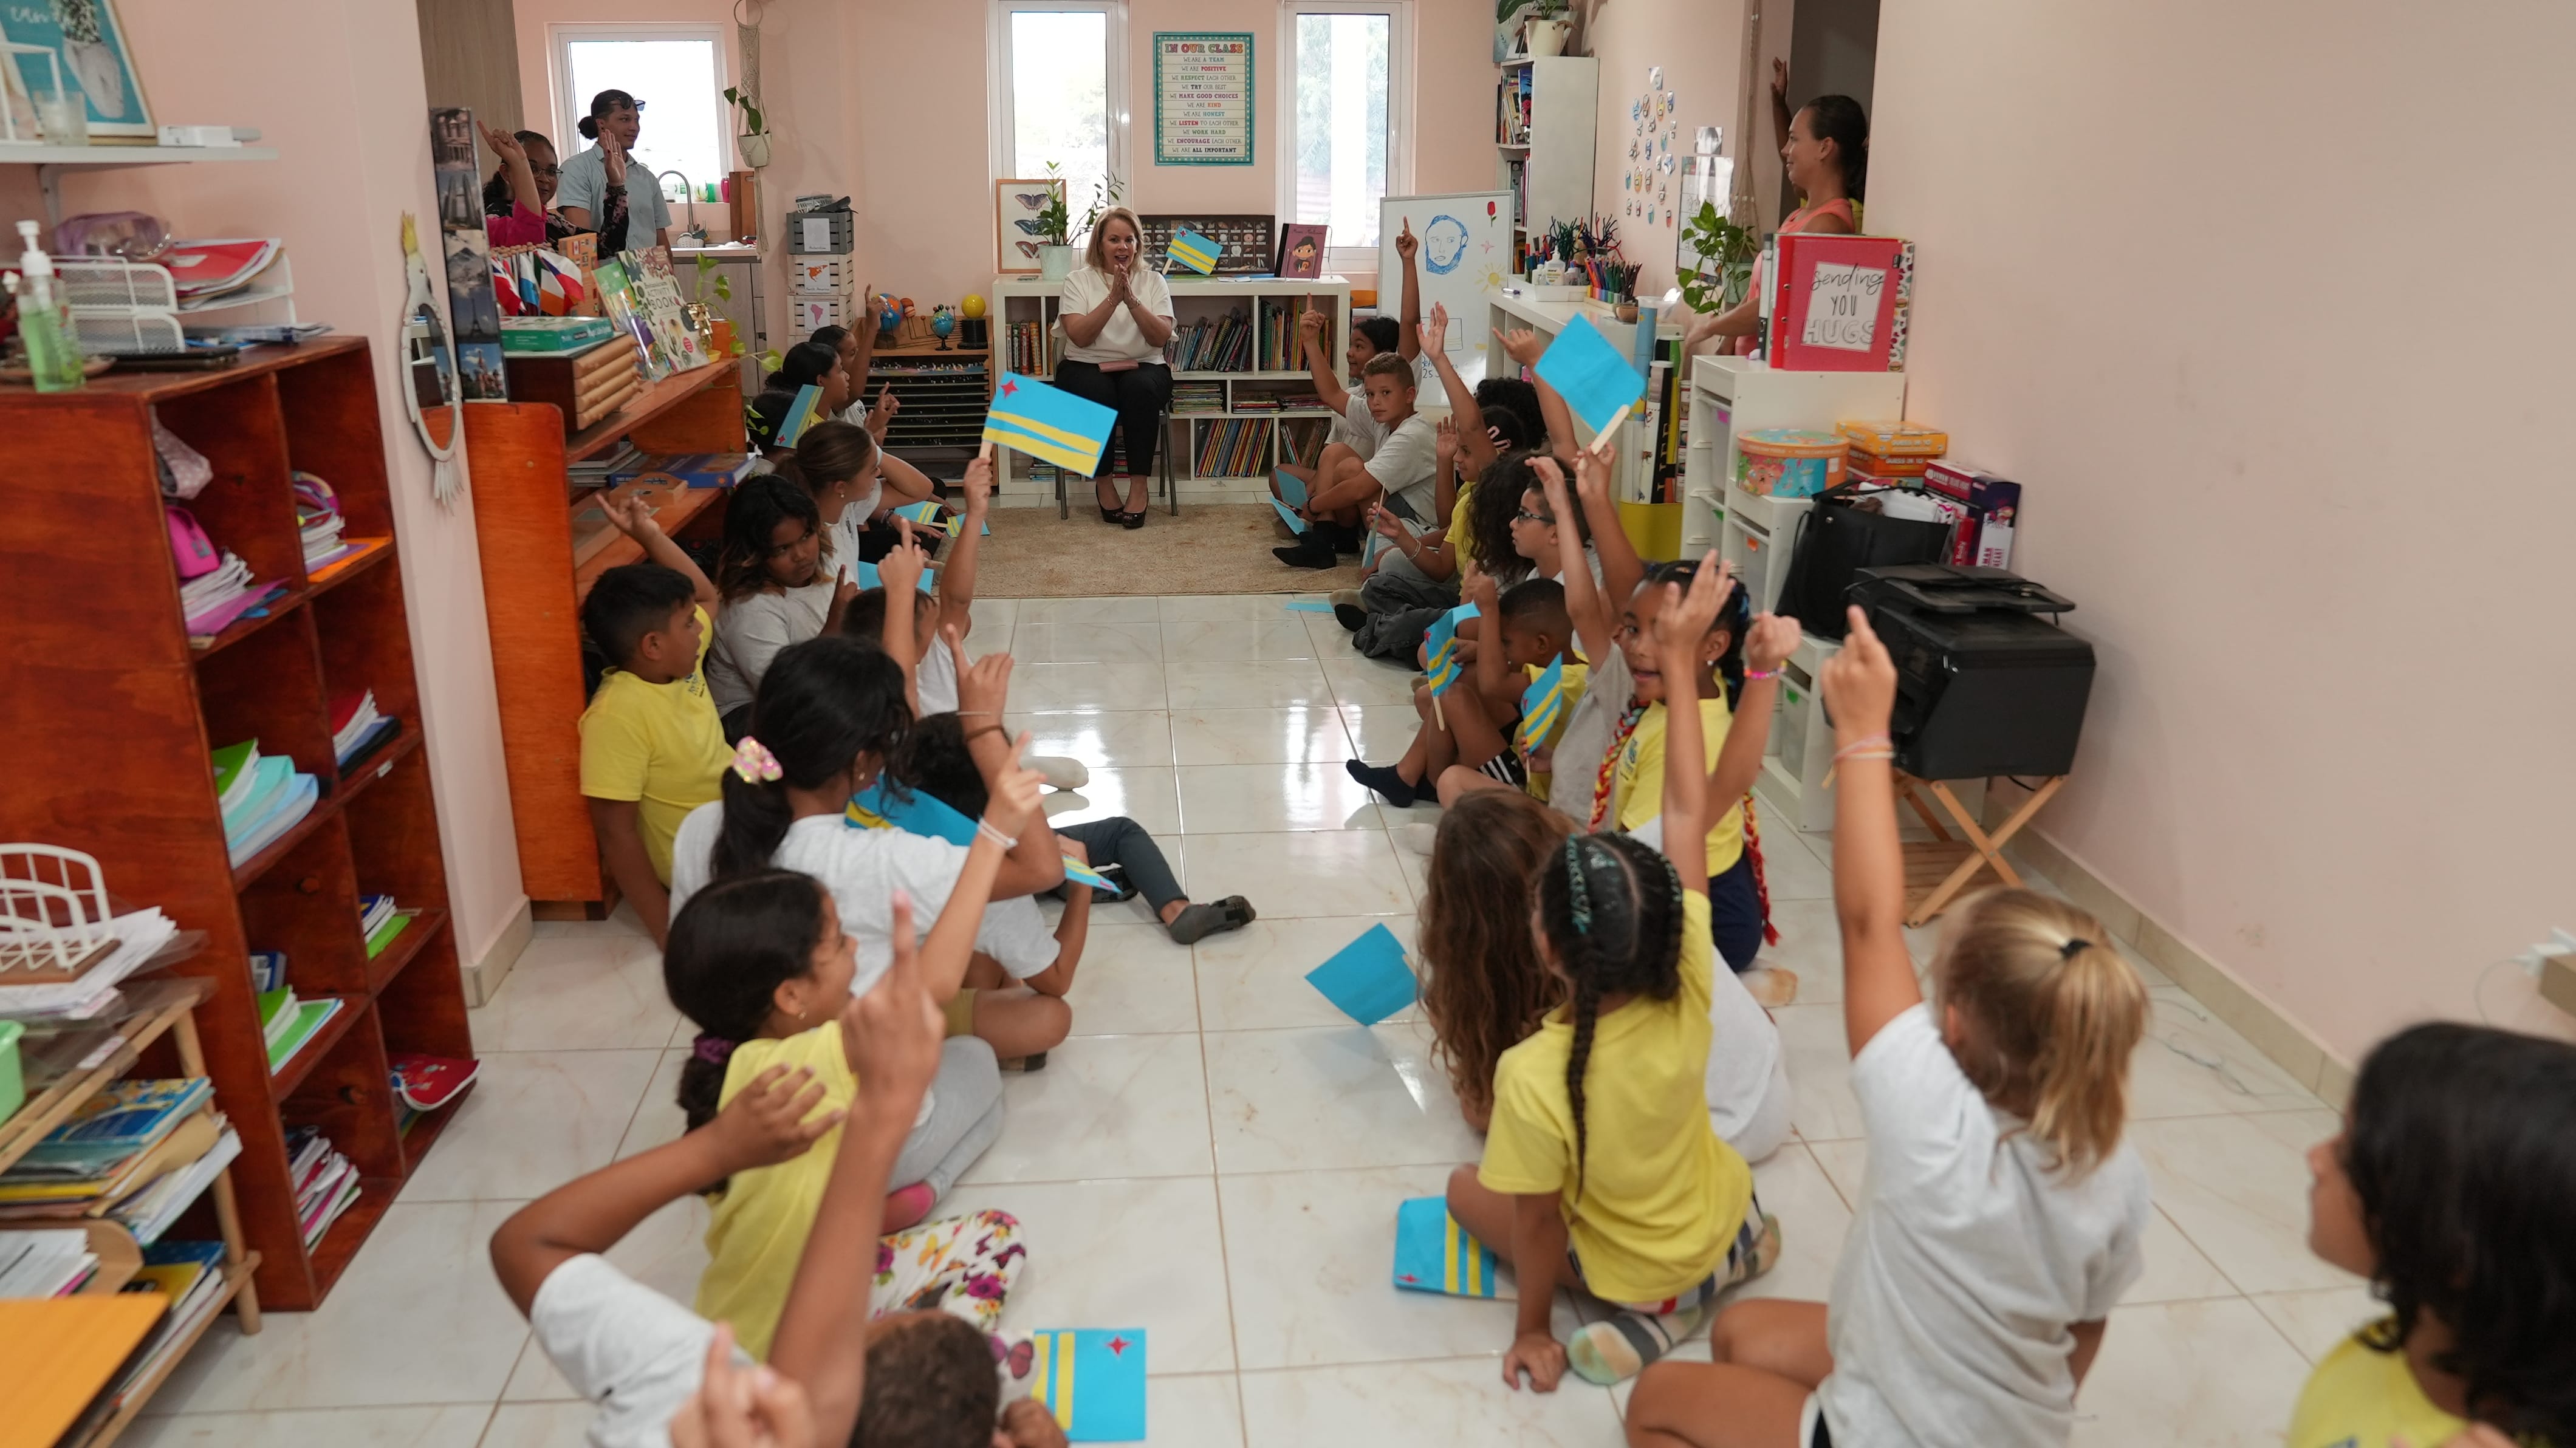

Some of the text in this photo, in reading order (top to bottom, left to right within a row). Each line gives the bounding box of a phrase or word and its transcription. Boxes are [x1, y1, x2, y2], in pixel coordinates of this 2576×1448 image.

[1165, 44, 1243, 53] IN OUR CLASS
[1811, 263, 1885, 296] sending
[648, 287, 671, 297] ACTIVITY
[651, 296, 676, 310] BOOK
[1831, 295, 1857, 316] YOU
[1802, 319, 1875, 344] HUGS
[1423, 368, 1433, 378] 25
[1955, 541, 1966, 559] Body
